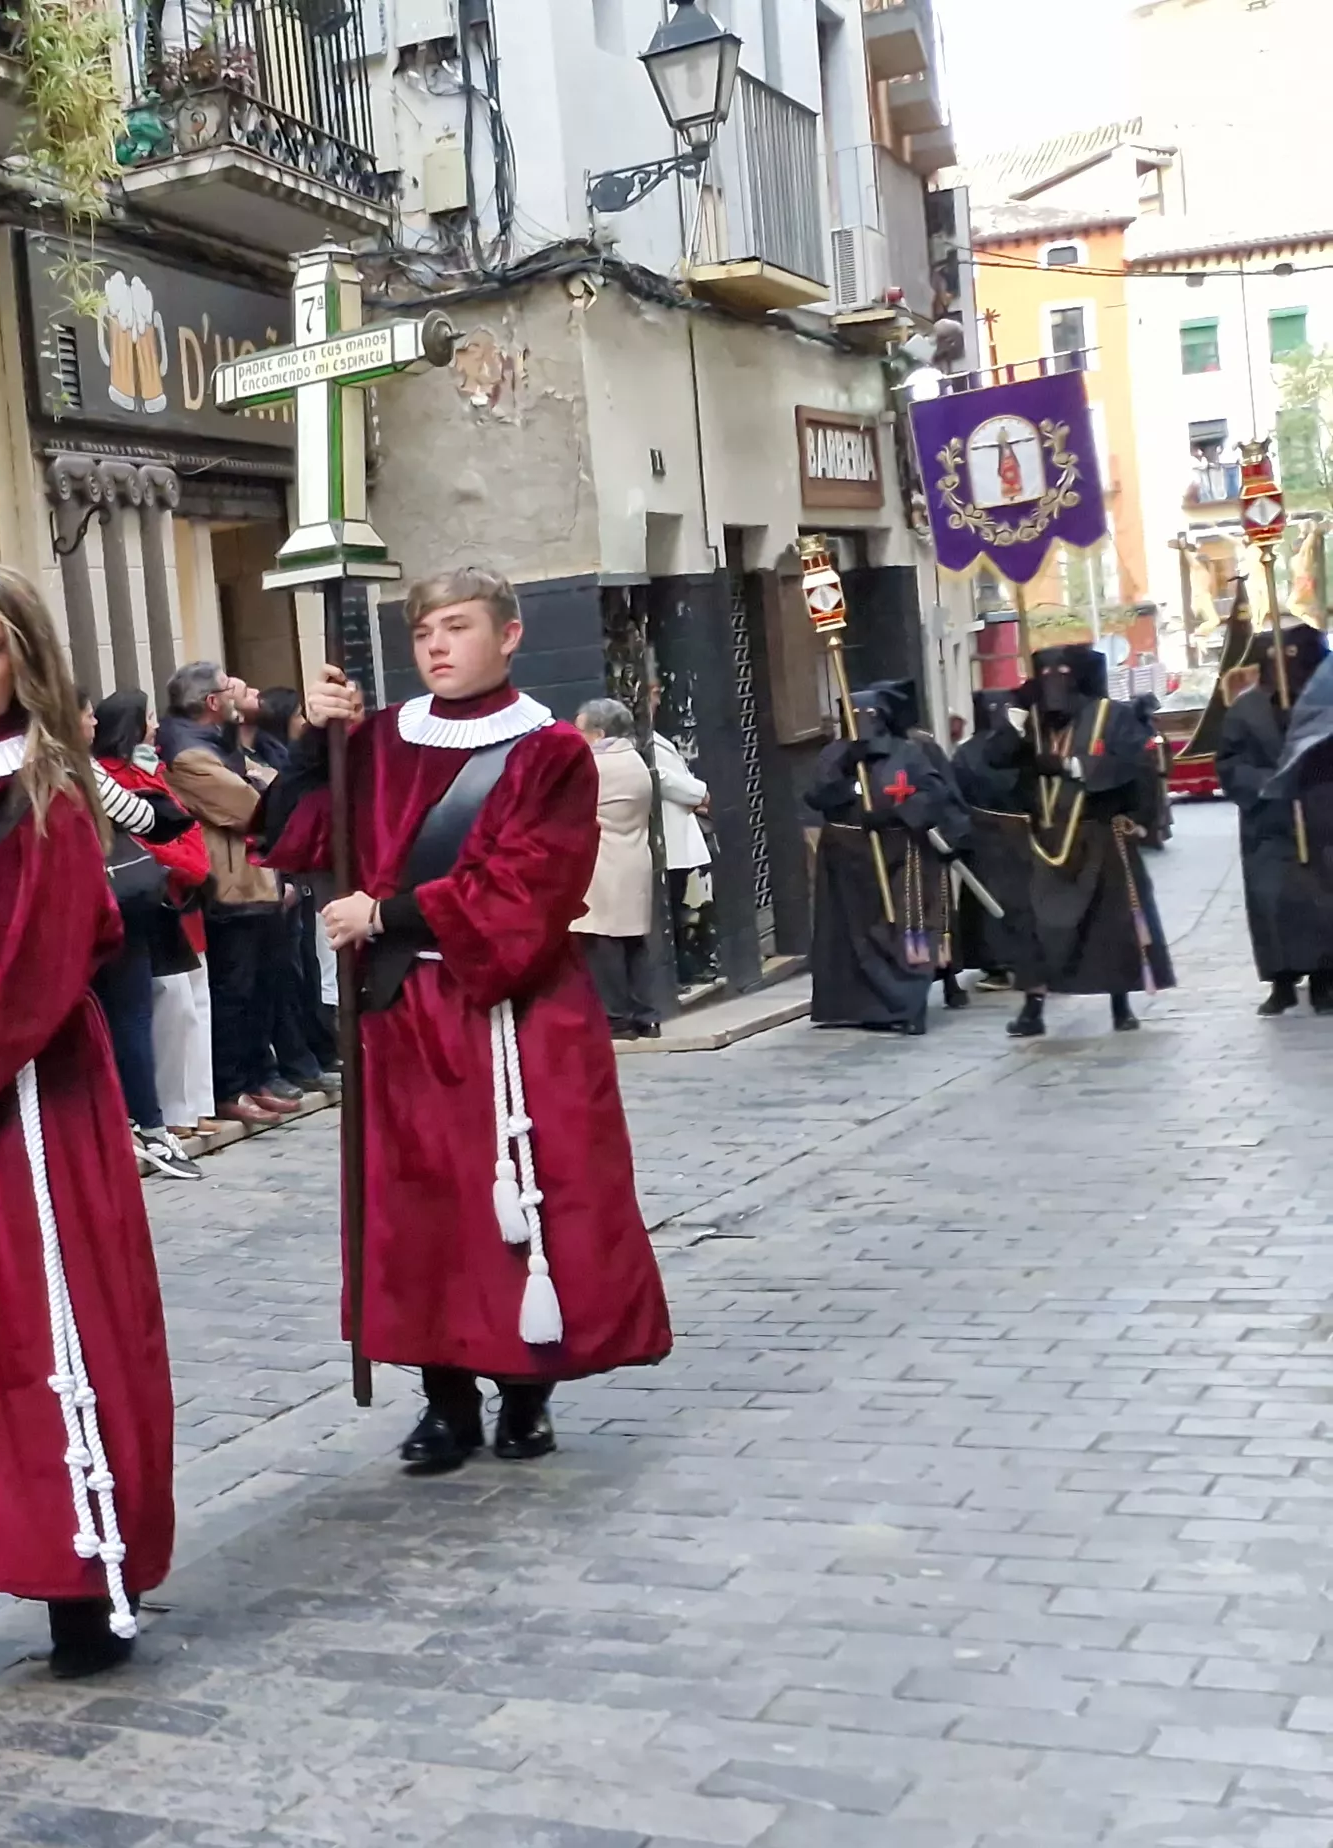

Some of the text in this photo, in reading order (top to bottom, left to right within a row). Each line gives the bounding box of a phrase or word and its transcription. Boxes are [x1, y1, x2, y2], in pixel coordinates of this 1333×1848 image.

[238, 360, 274, 380] PADRE
[278, 354, 299, 368] MIO
[321, 343, 342, 358] TUS
[346, 332, 387, 351] MANOS
[242, 350, 384, 392] ENCOMIENDO MI ESPIRITU
